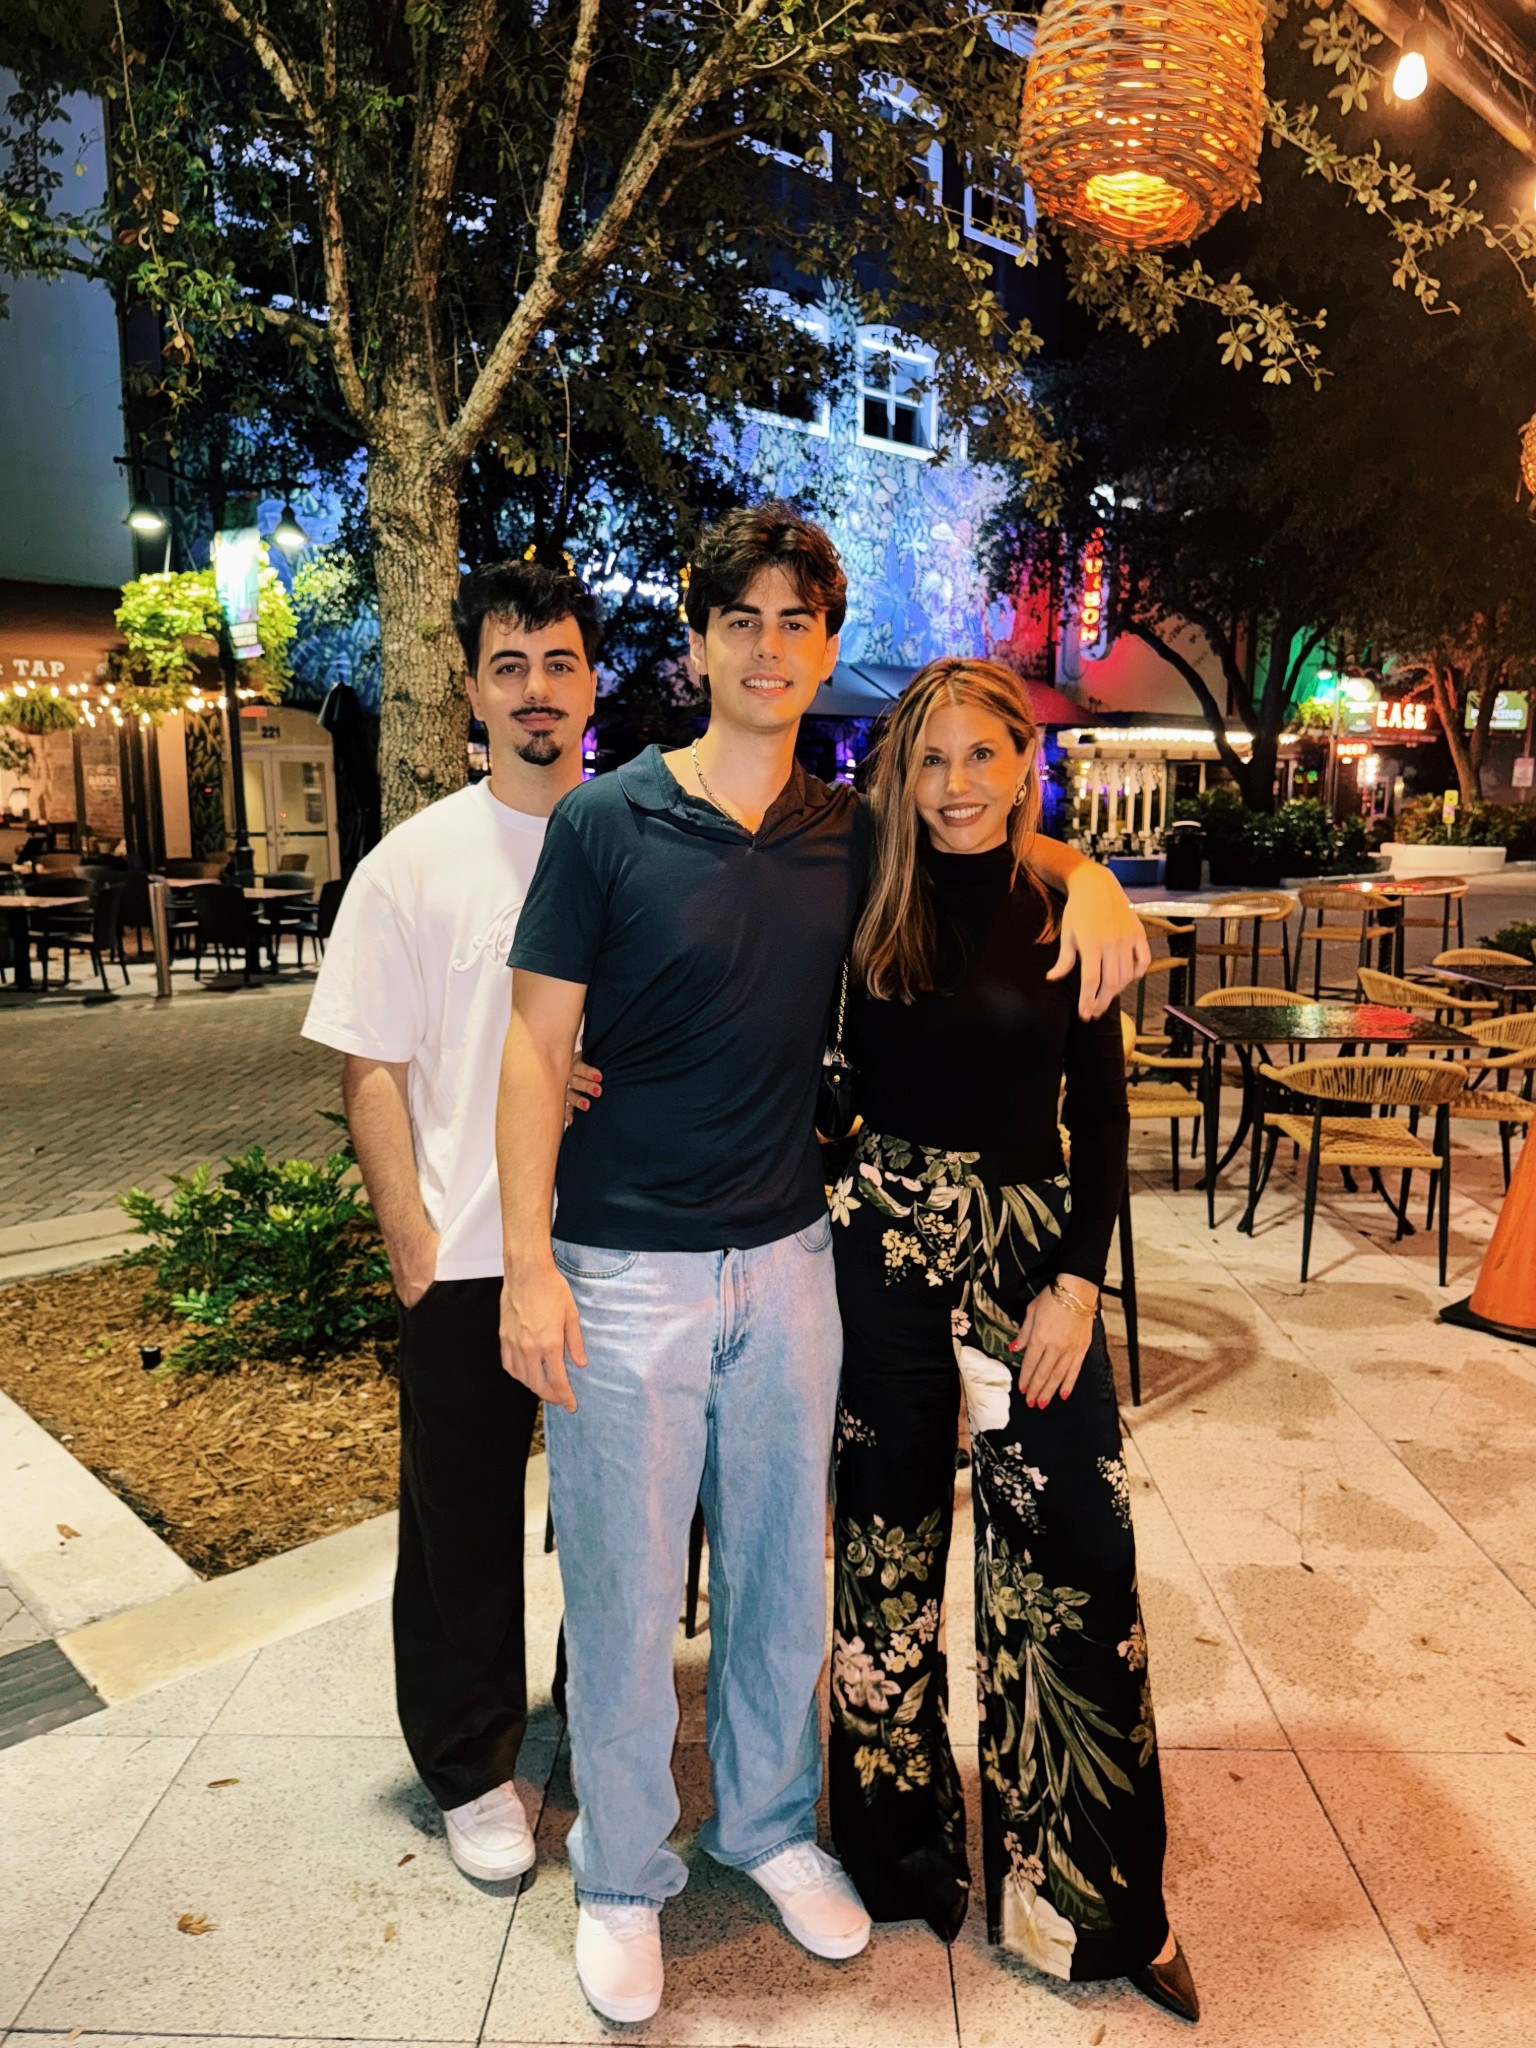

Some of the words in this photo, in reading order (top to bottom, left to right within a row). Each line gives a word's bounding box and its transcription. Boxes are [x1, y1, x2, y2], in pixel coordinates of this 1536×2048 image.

[12, 659, 65, 678] TAP
[1470, 708, 1523, 720] PKING
[261, 726, 280, 739] 221
